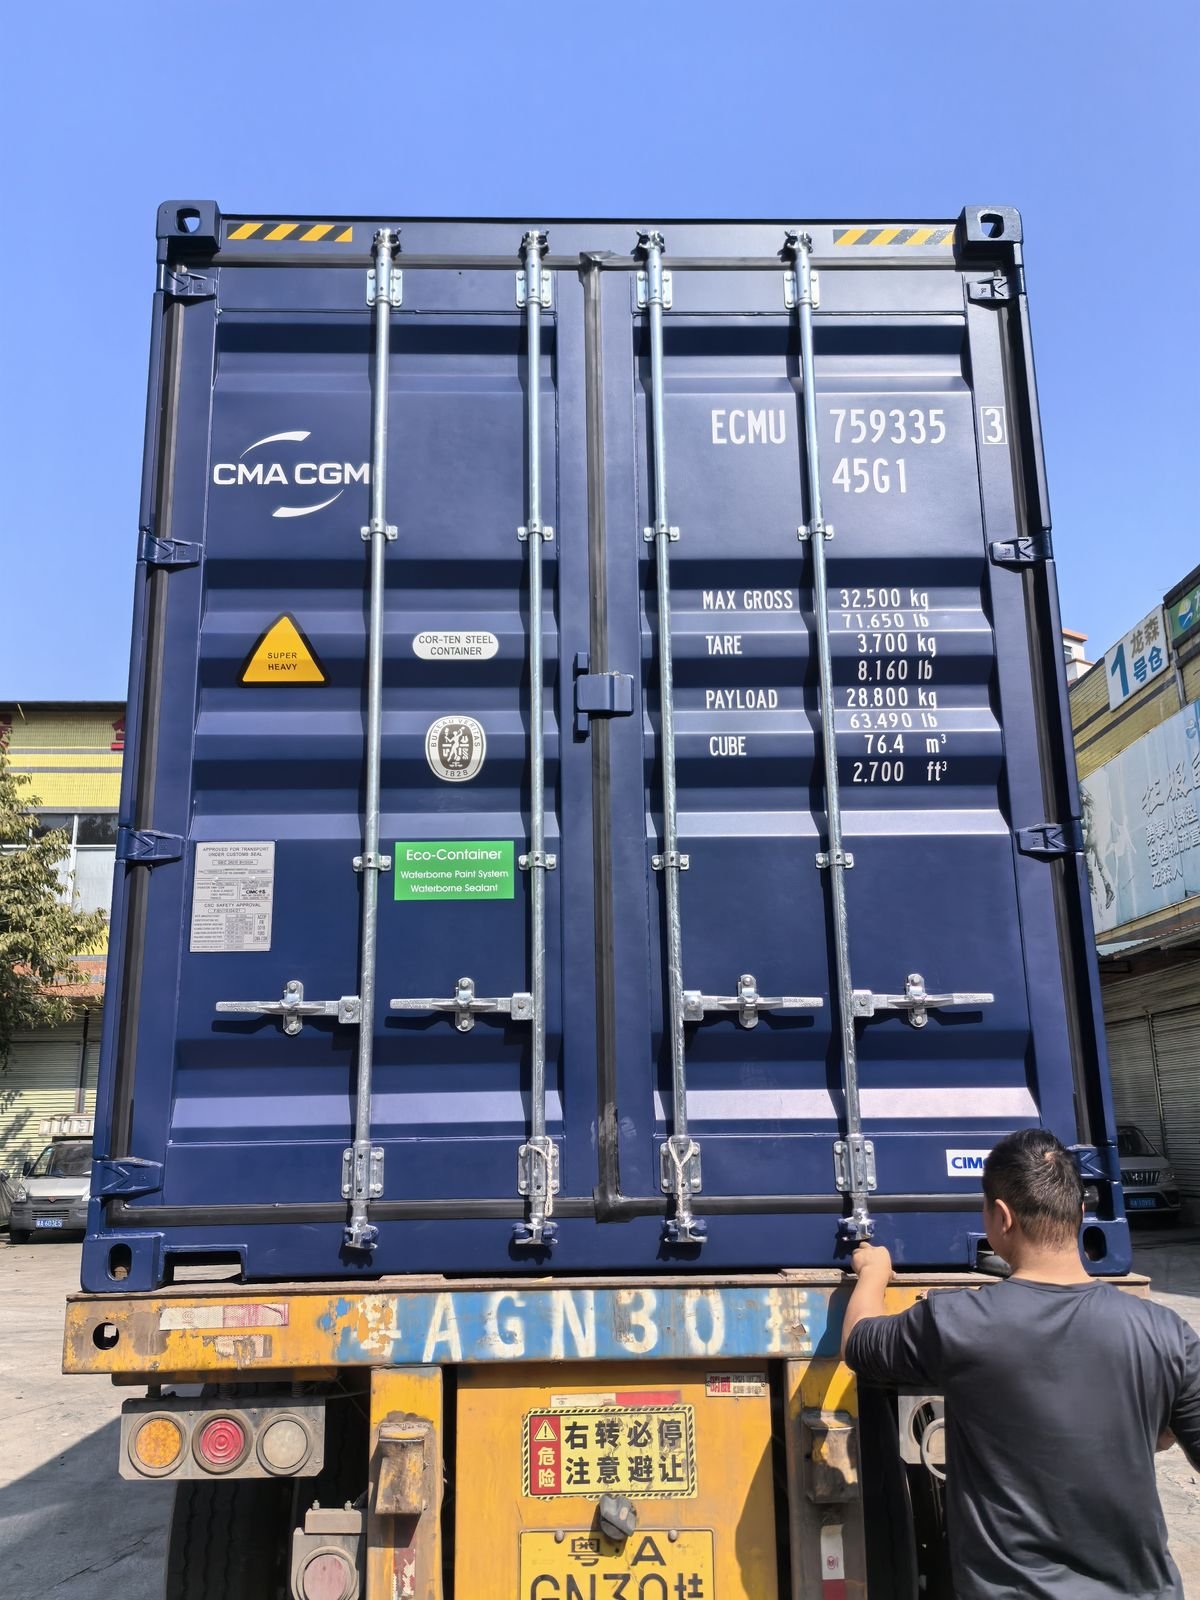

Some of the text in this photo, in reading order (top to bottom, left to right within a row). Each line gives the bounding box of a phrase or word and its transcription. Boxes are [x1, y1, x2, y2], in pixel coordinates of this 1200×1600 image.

[711, 408, 1003, 444] ECMU 759335 3
[213, 463, 371, 485] CMA CGM
[831, 457, 907, 493] 45G1
[702, 590, 736, 610] MAX
[743, 590, 793, 609] GROSS
[910, 588, 929, 611] kg
[912, 613, 929, 628] lb
[418, 635, 494, 645] COR-TEN STEEL
[705, 635, 743, 654] TARE
[917, 633, 937, 657] kg
[1130, 616, 1160, 659] 龙森
[267, 652, 298, 660] SUPER
[430, 646, 482, 656] CONTAINER
[268, 663, 298, 671] HEAVY
[918, 660, 933, 680] lb
[1110, 642, 1130, 698] 1
[1133, 646, 1164, 683] 号仓
[705, 689, 778, 709] PAYLOAD
[918, 687, 937, 709] kg
[921, 713, 938, 728] lb
[431, 719, 481, 748] BUREAU VERITAS
[709, 736, 747, 756] CUBE
[864, 733, 905, 754] 76.4
[445, 769, 468, 777] 1828
[406, 848, 502, 861] Eco-Container
[400, 869, 509, 880] Waterborne Paint System
[410, 883, 498, 893] Waterborne Sealant
[951, 1156, 985, 1169] CIM
[564, 1419, 683, 1450] 右转必停
[537, 1446, 556, 1489] 危险
[565, 1454, 684, 1486] 注意避让
